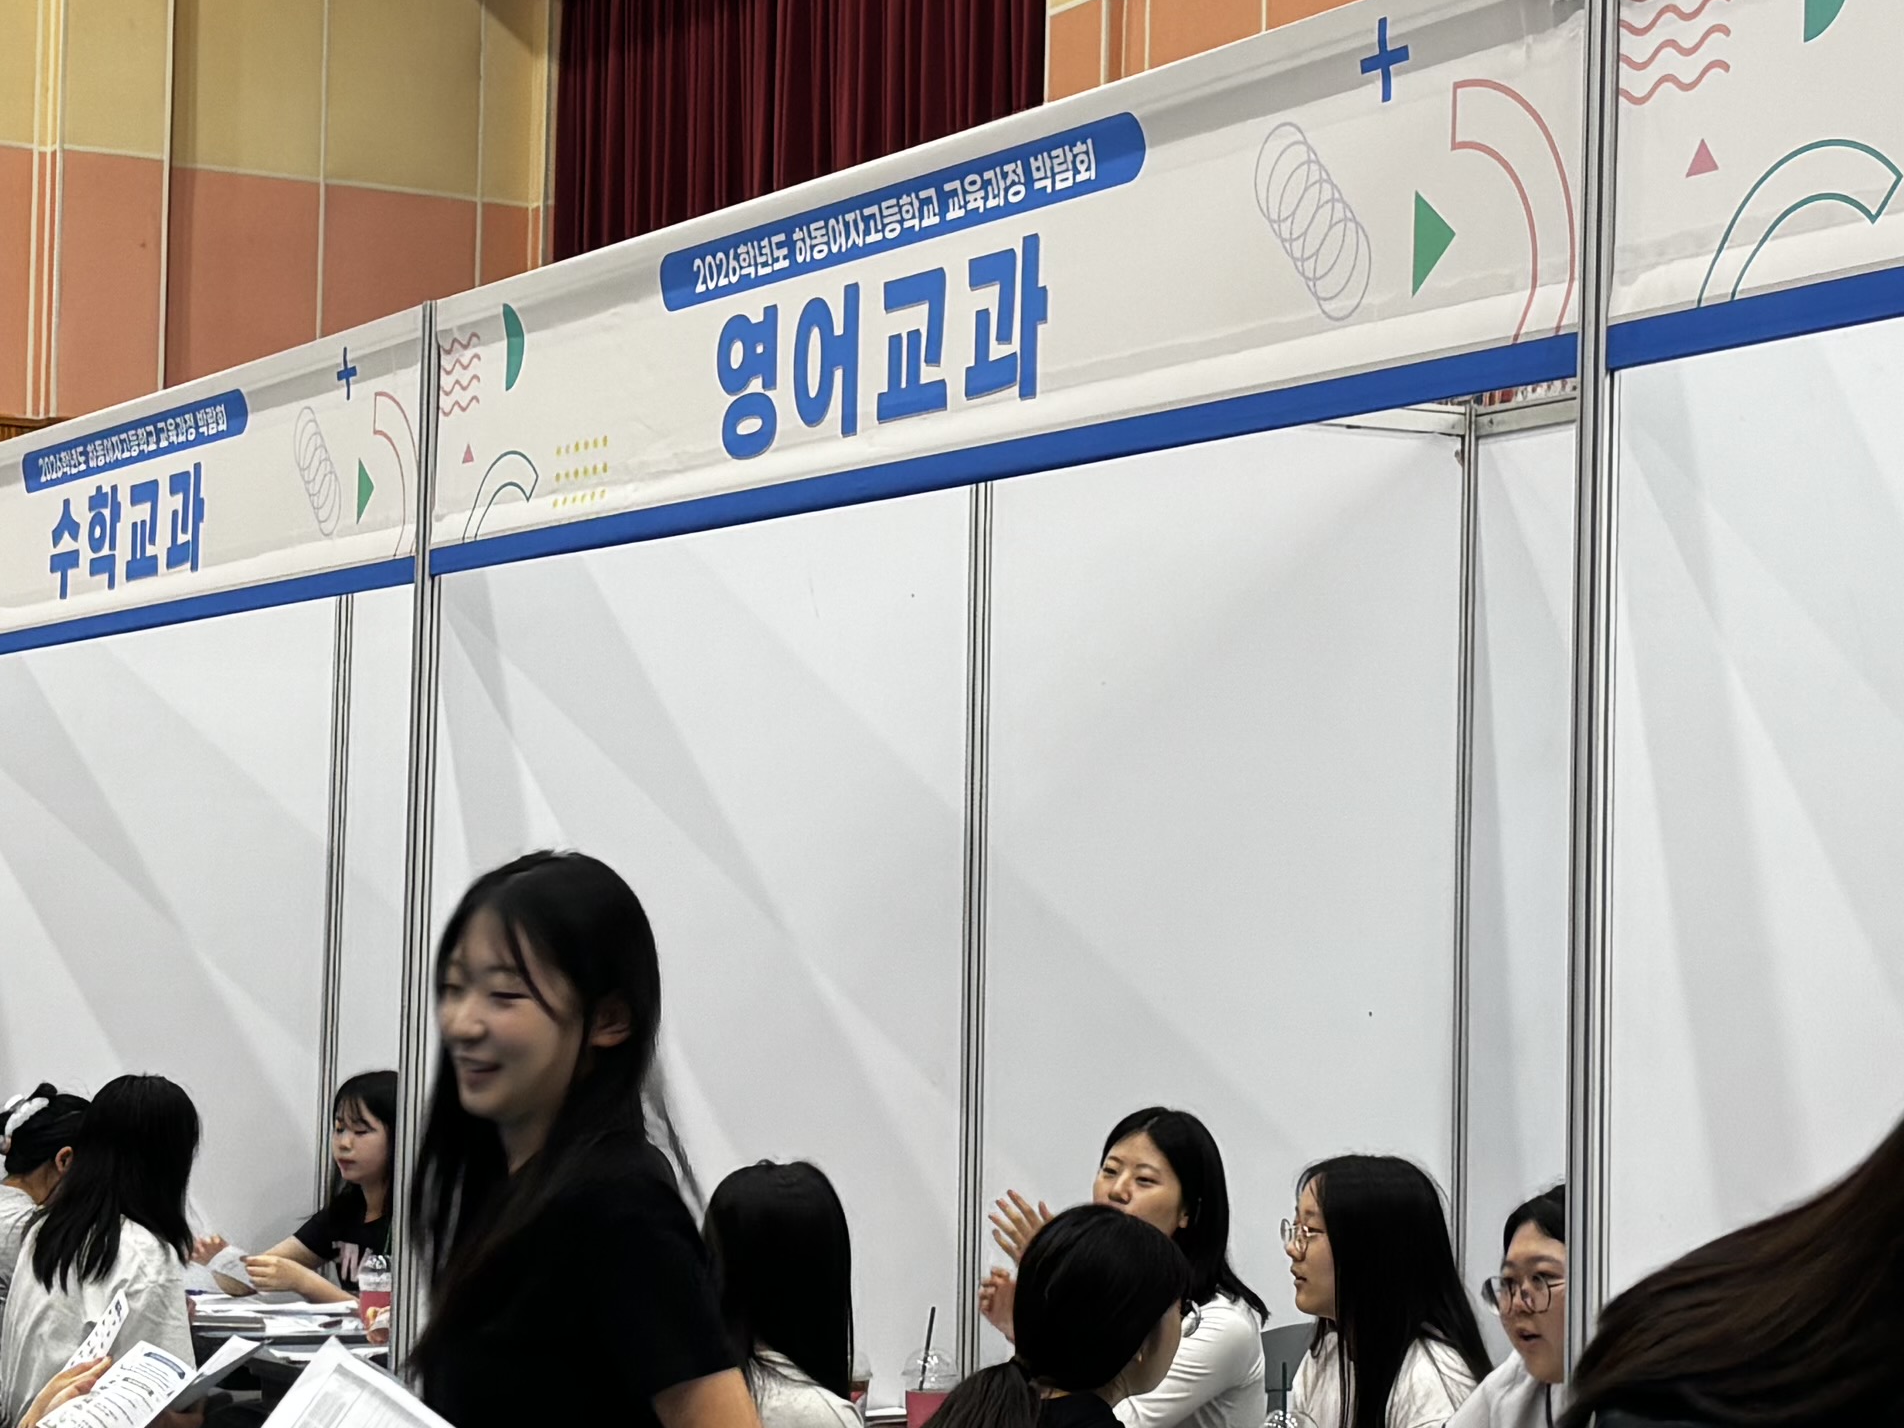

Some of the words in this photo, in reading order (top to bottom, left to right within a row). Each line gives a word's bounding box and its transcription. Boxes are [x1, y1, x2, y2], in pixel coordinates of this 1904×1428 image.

[692, 232, 790, 294] 2026학년도
[794, 189, 940, 264] 하동여자고등학교
[944, 159, 1026, 217] 교육과정
[1030, 137, 1097, 193] 박람회
[717, 232, 1049, 460] 영어교과
[49, 461, 205, 600] 수학교과
